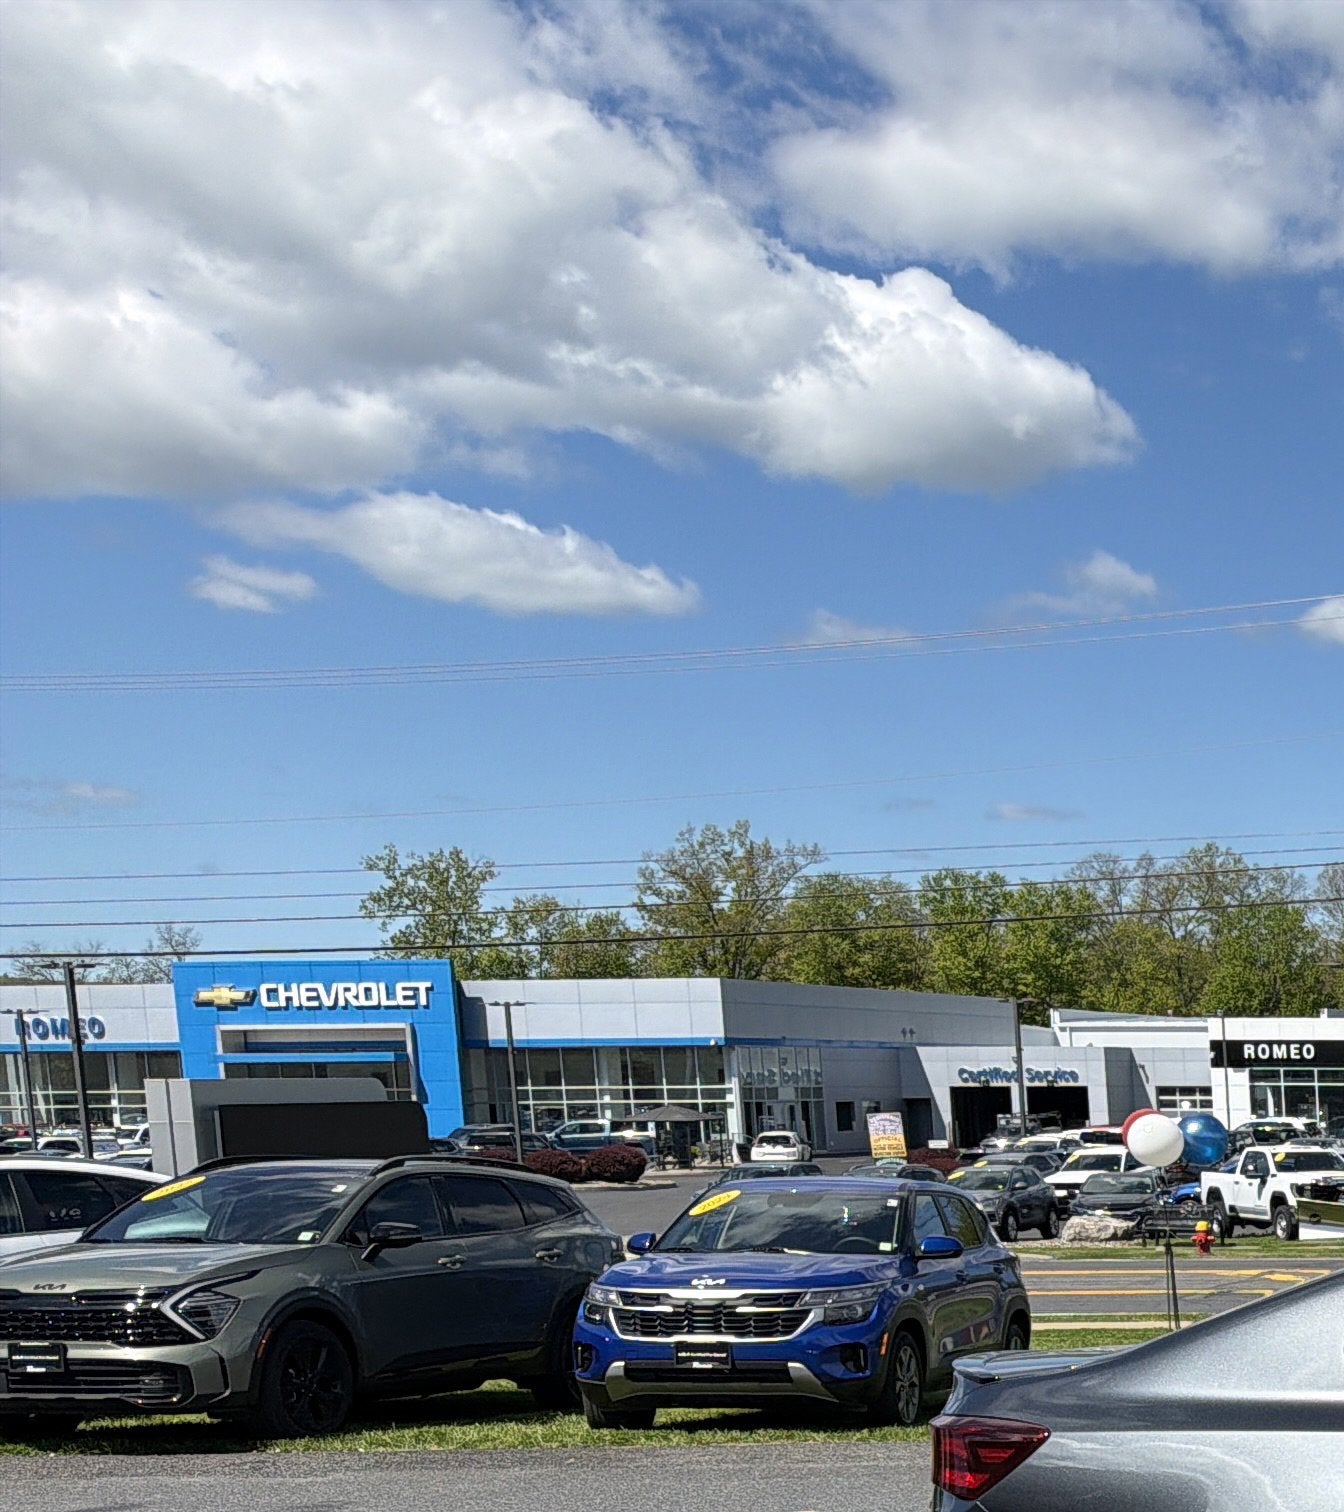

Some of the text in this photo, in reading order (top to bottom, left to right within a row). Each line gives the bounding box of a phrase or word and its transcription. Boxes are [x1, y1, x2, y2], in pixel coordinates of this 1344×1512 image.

[259, 981, 433, 1008] CHEVROLET
[1243, 1043, 1315, 1060] ROMEO
[1025, 1066, 1080, 1084] Service
